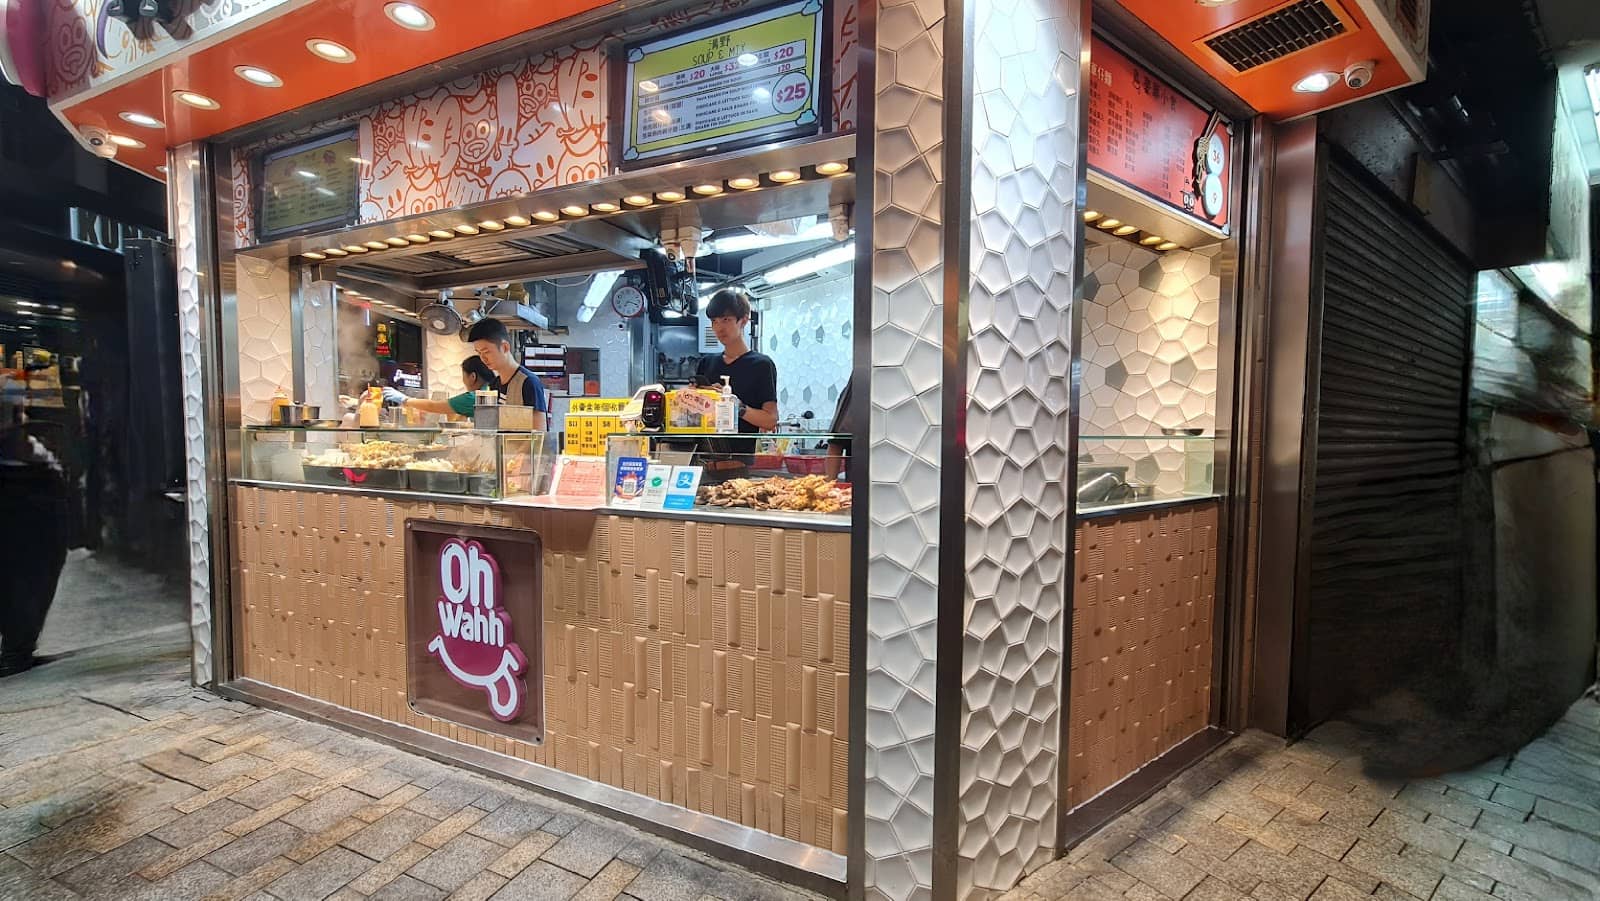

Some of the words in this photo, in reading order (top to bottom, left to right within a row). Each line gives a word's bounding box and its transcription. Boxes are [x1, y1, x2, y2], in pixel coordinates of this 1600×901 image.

[692, 47, 714, 66] SOUP
[774, 47, 794, 61] $20
[689, 69, 706, 82] $20
[776, 82, 807, 103] $25
[440, 542, 494, 609] Oh
[437, 600, 504, 648] Wahh
